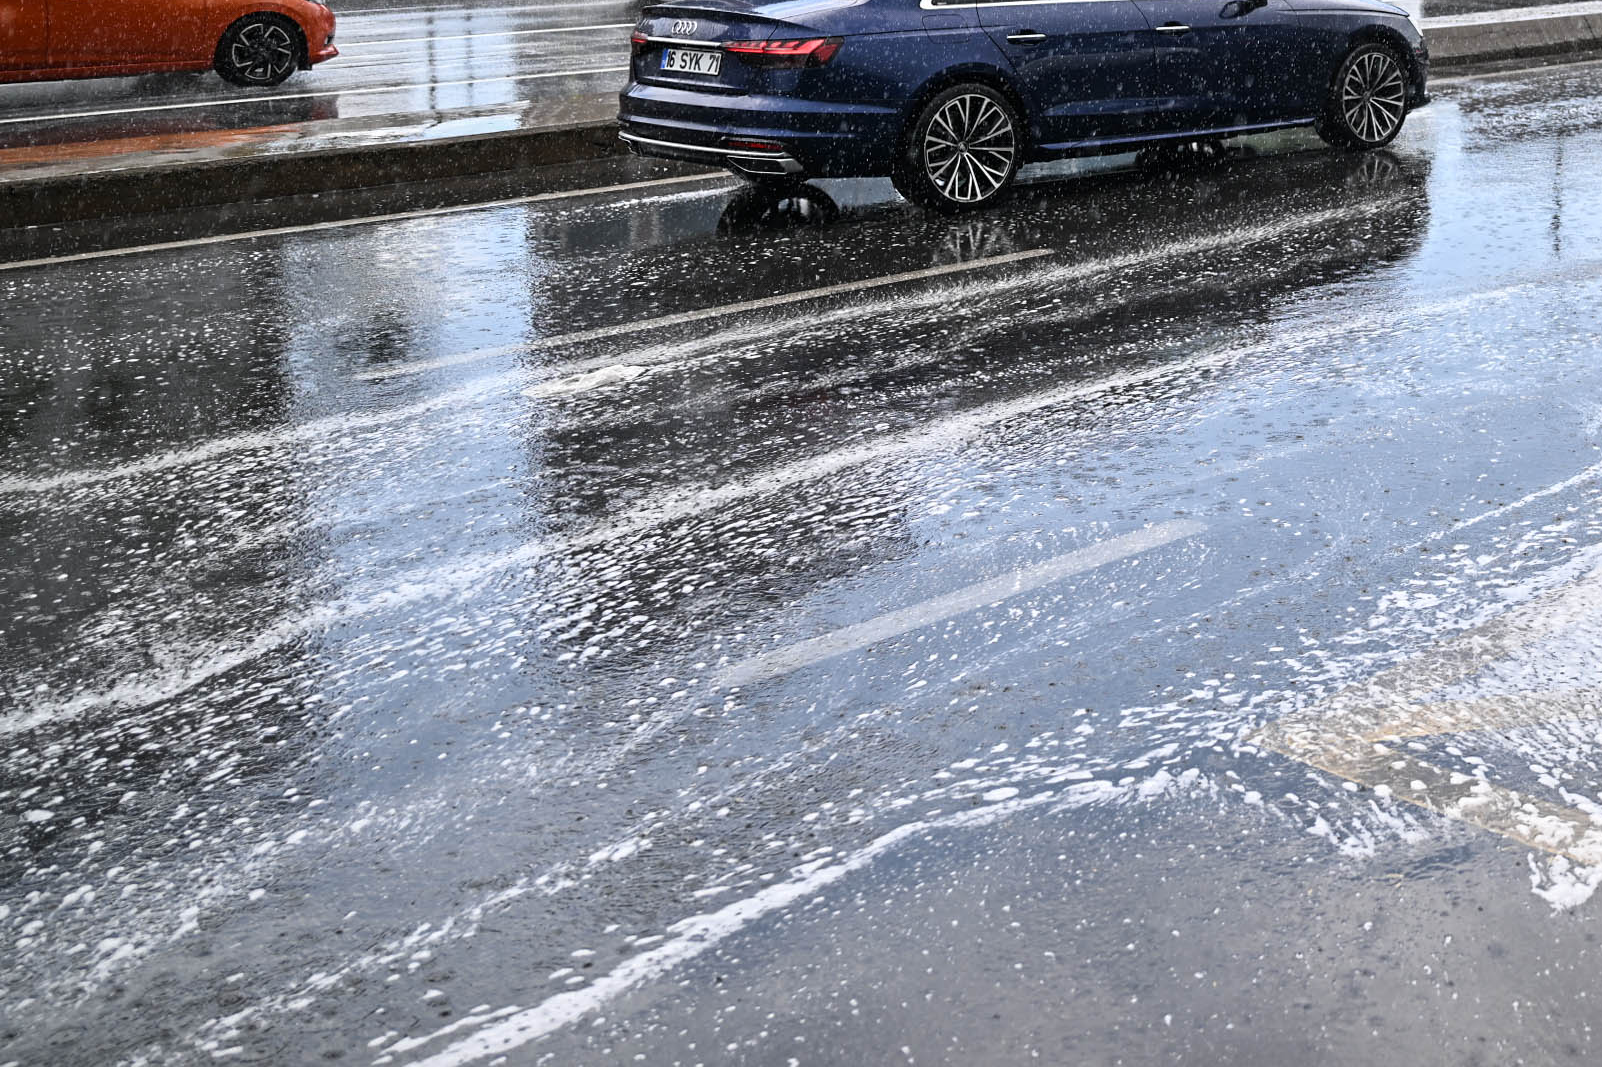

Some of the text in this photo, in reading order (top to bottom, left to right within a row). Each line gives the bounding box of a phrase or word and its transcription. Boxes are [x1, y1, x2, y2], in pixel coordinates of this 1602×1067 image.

[666, 50, 720, 73] 16 SYK 71
